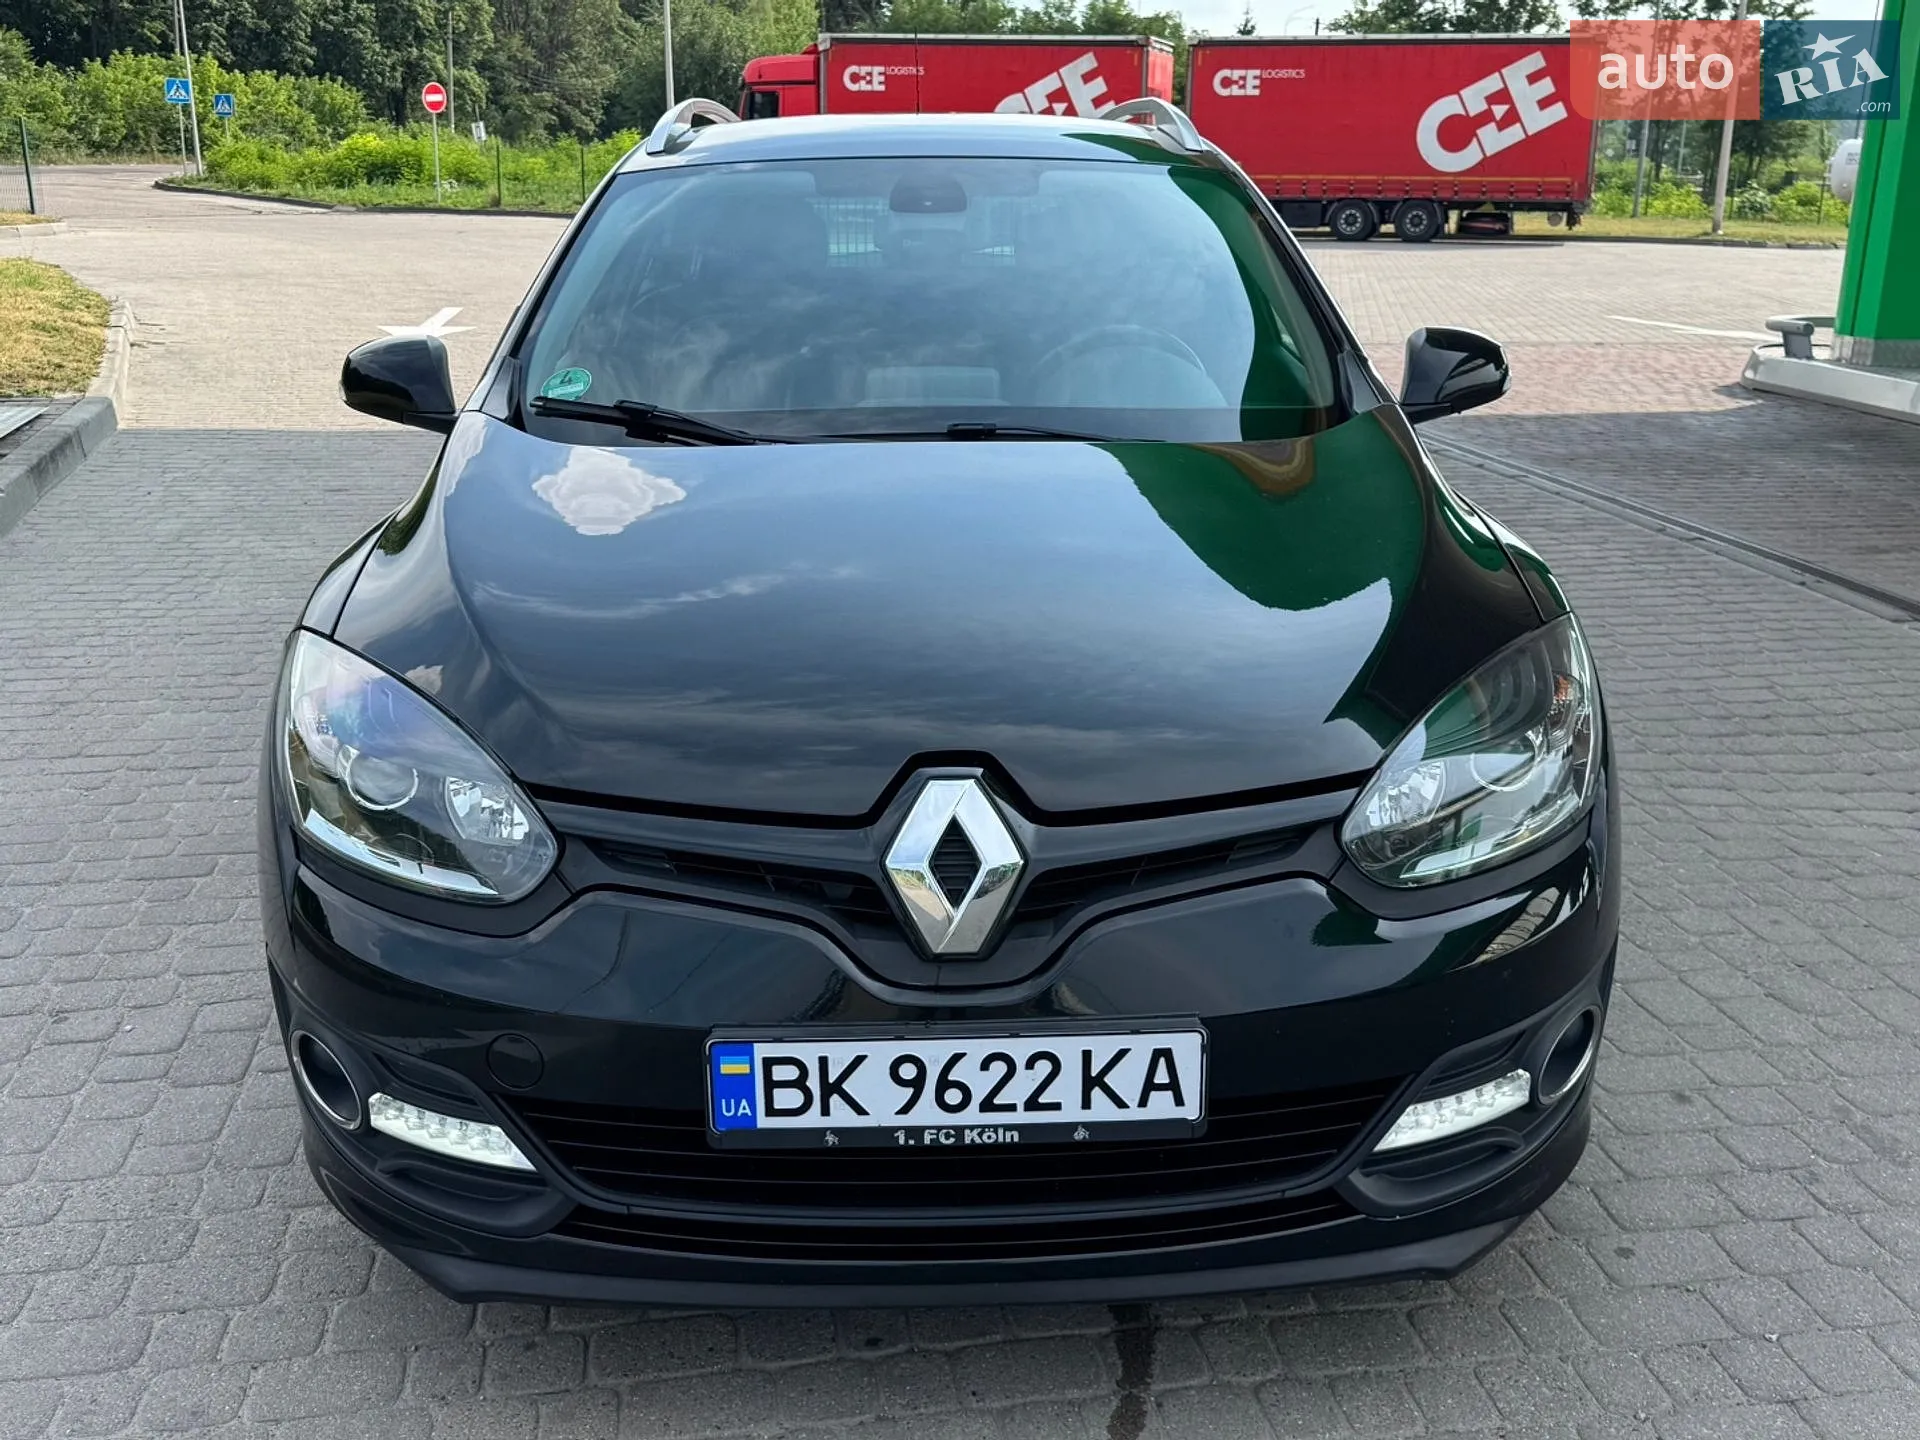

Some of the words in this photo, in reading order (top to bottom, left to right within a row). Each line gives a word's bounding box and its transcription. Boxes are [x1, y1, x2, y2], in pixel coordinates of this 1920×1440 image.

[843, 65, 886, 92] CEE
[993, 51, 1117, 119] EE
[1212, 68, 1261, 96] CEE
[1261, 69, 1306, 79] LOGISTICS
[1413, 50, 1569, 173] CEE
[761, 1053, 871, 1118] BK
[888, 1051, 1064, 1116] 9622
[1079, 1046, 1186, 1111] KA
[721, 1098, 753, 1118] UA
[893, 1129, 915, 1146] 1.
[923, 1128, 957, 1145] FC
[963, 1126, 1020, 1144] Köln
